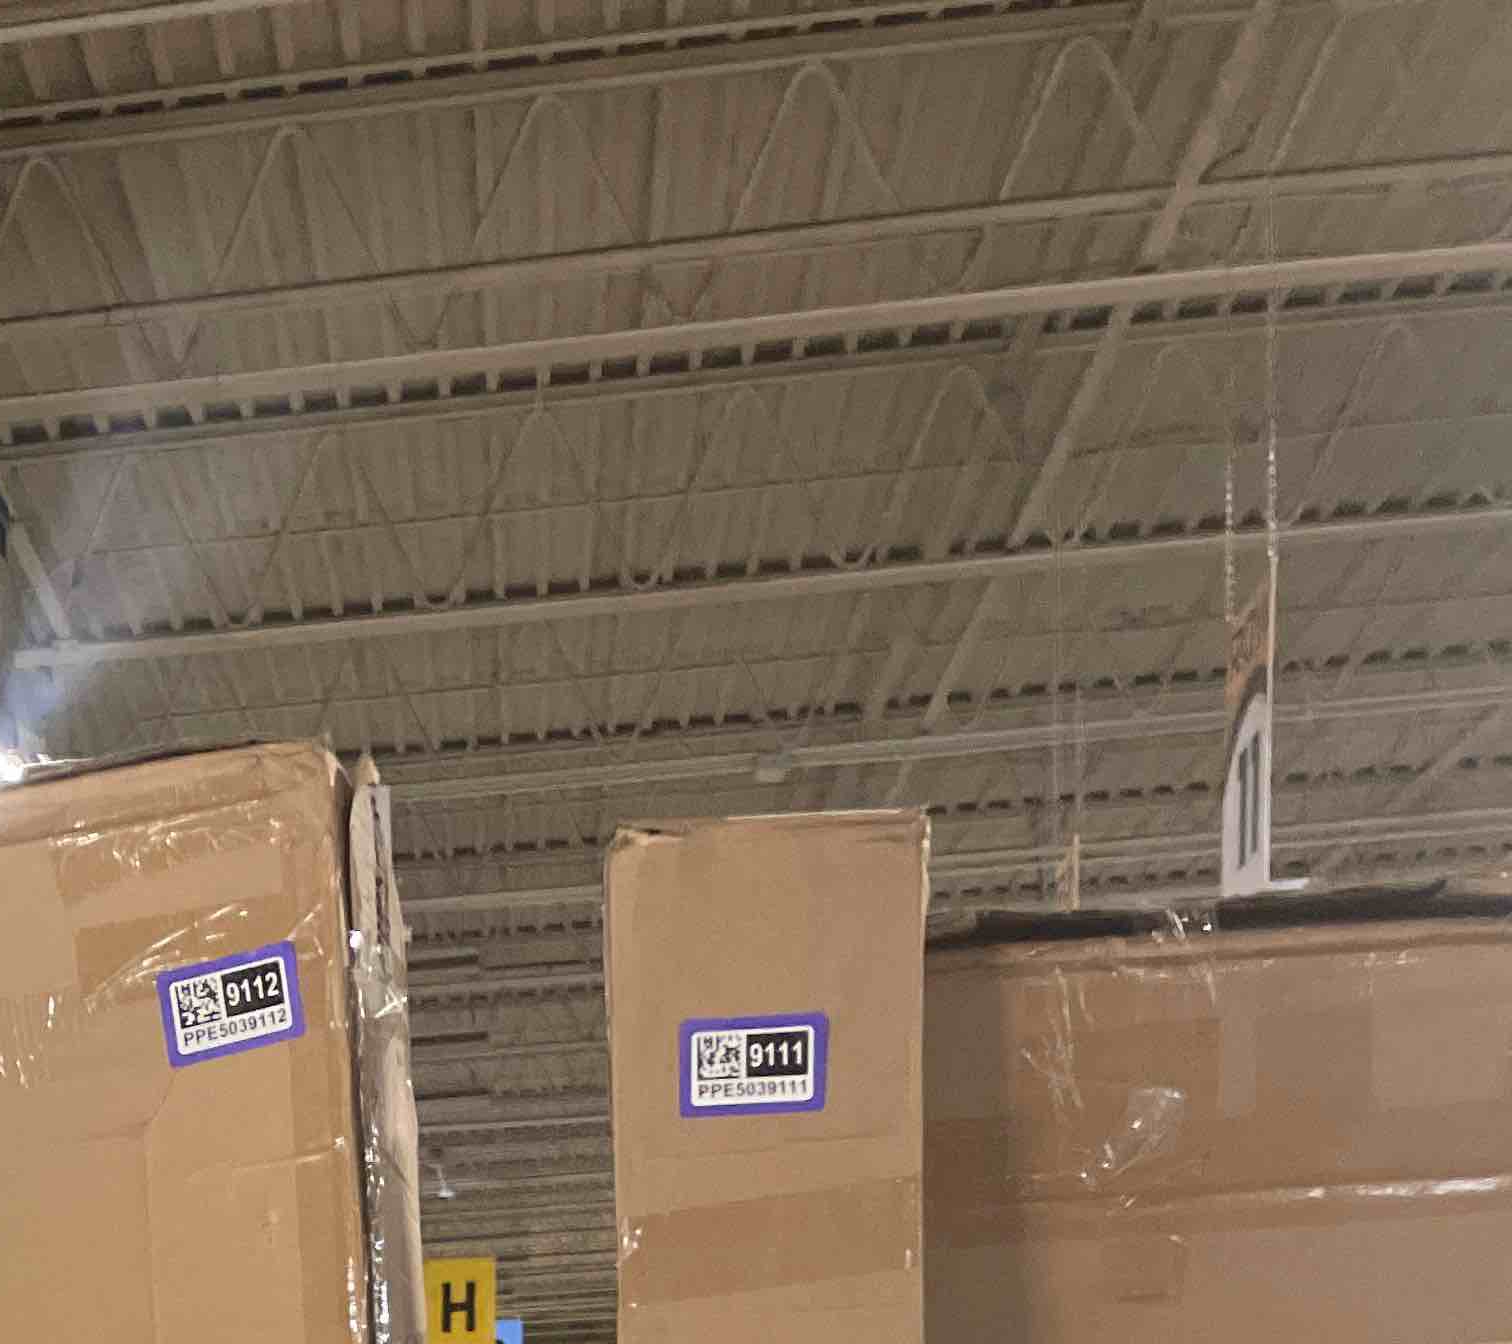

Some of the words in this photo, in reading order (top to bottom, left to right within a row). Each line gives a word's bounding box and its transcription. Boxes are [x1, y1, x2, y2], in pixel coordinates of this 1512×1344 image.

[225, 971, 280, 1007] 9112
[183, 1008, 287, 1047] PPE5039112
[749, 1040, 803, 1068] 9111
[698, 1079, 807, 1099] PPE5039111
[441, 1281, 476, 1333] H
